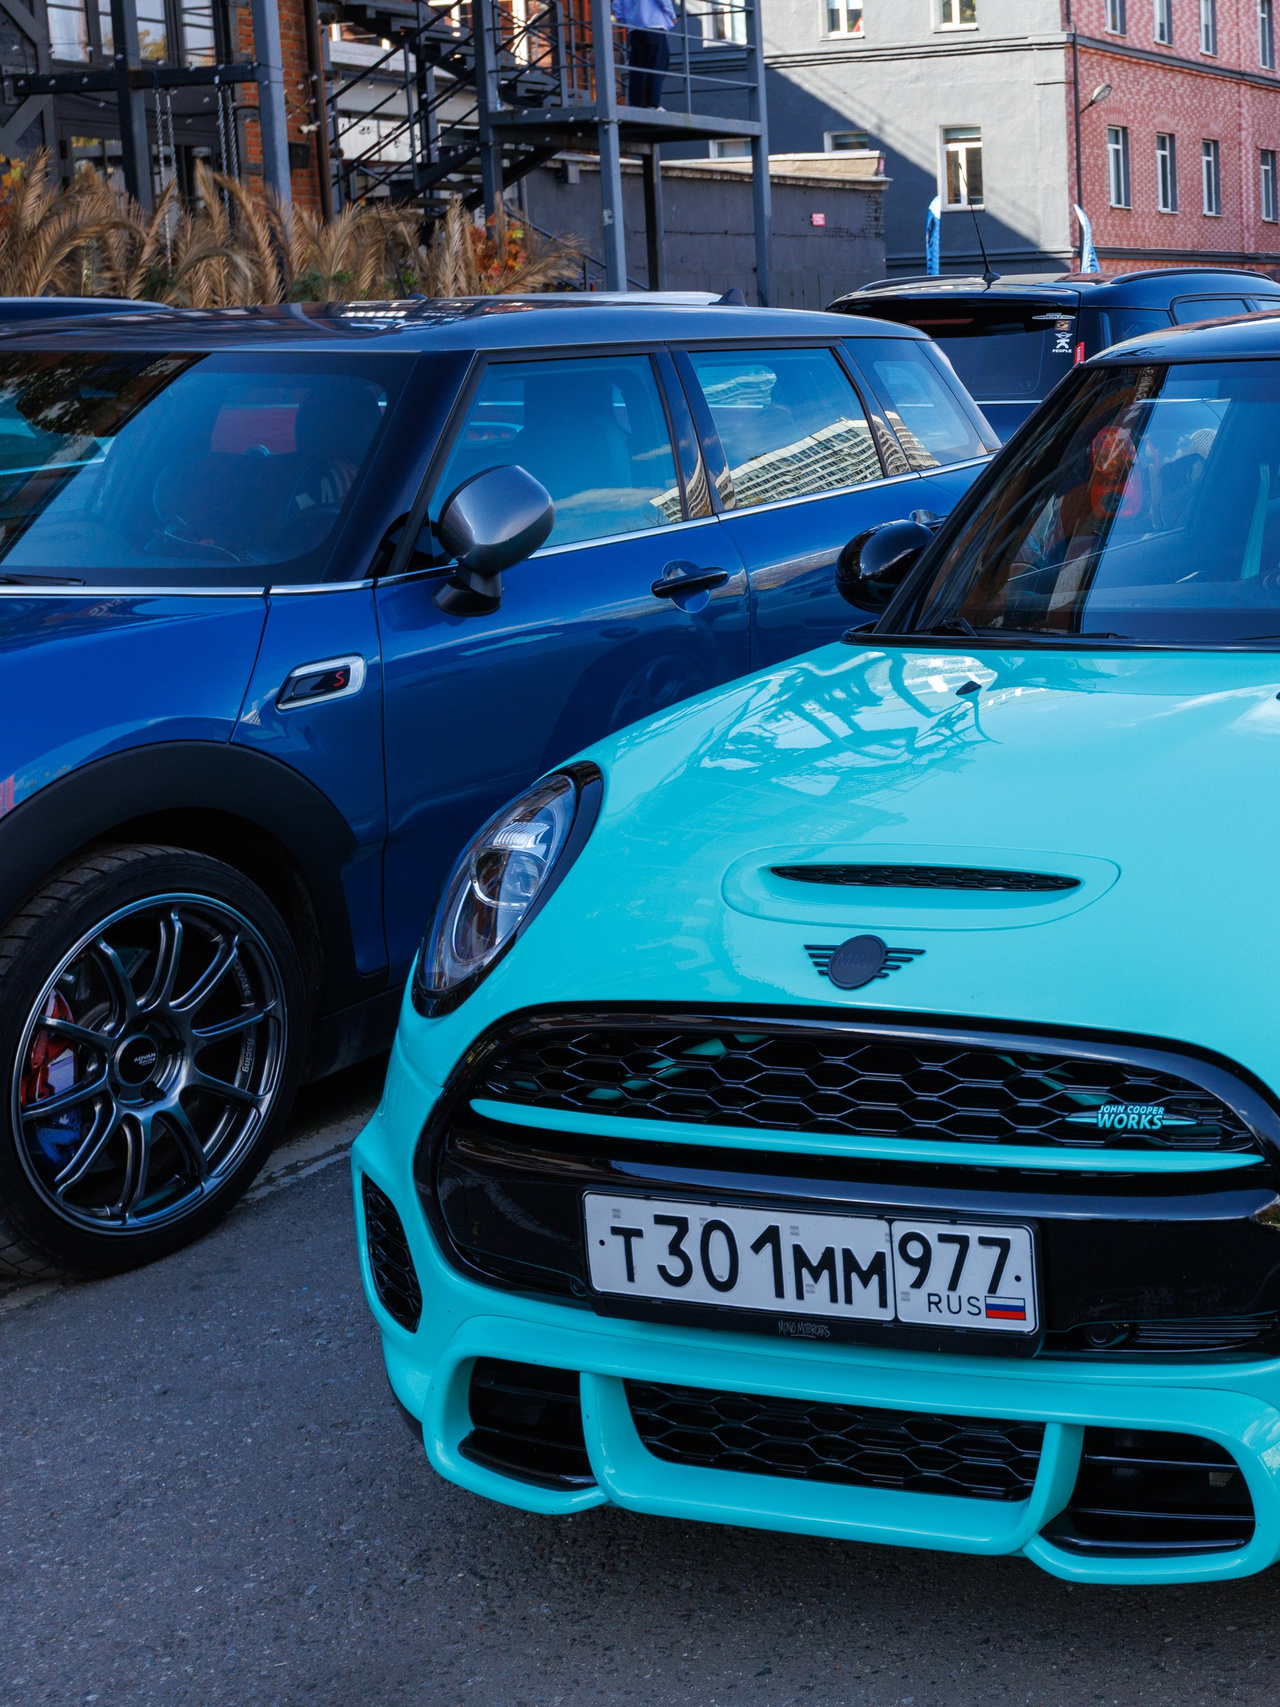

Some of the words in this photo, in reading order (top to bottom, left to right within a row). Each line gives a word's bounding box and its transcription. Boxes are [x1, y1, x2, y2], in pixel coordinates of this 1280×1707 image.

[333, 670, 345, 687] S
[836, 953, 877, 967] MINI
[242, 1037, 255, 1073] Racing
[1098, 1105, 1126, 1113] JOHN
[1127, 1105, 1165, 1114] COOPER
[1097, 1113, 1163, 1129] WORKS
[898, 1231, 1011, 1295] 977
[927, 1292, 982, 1316] RUS
